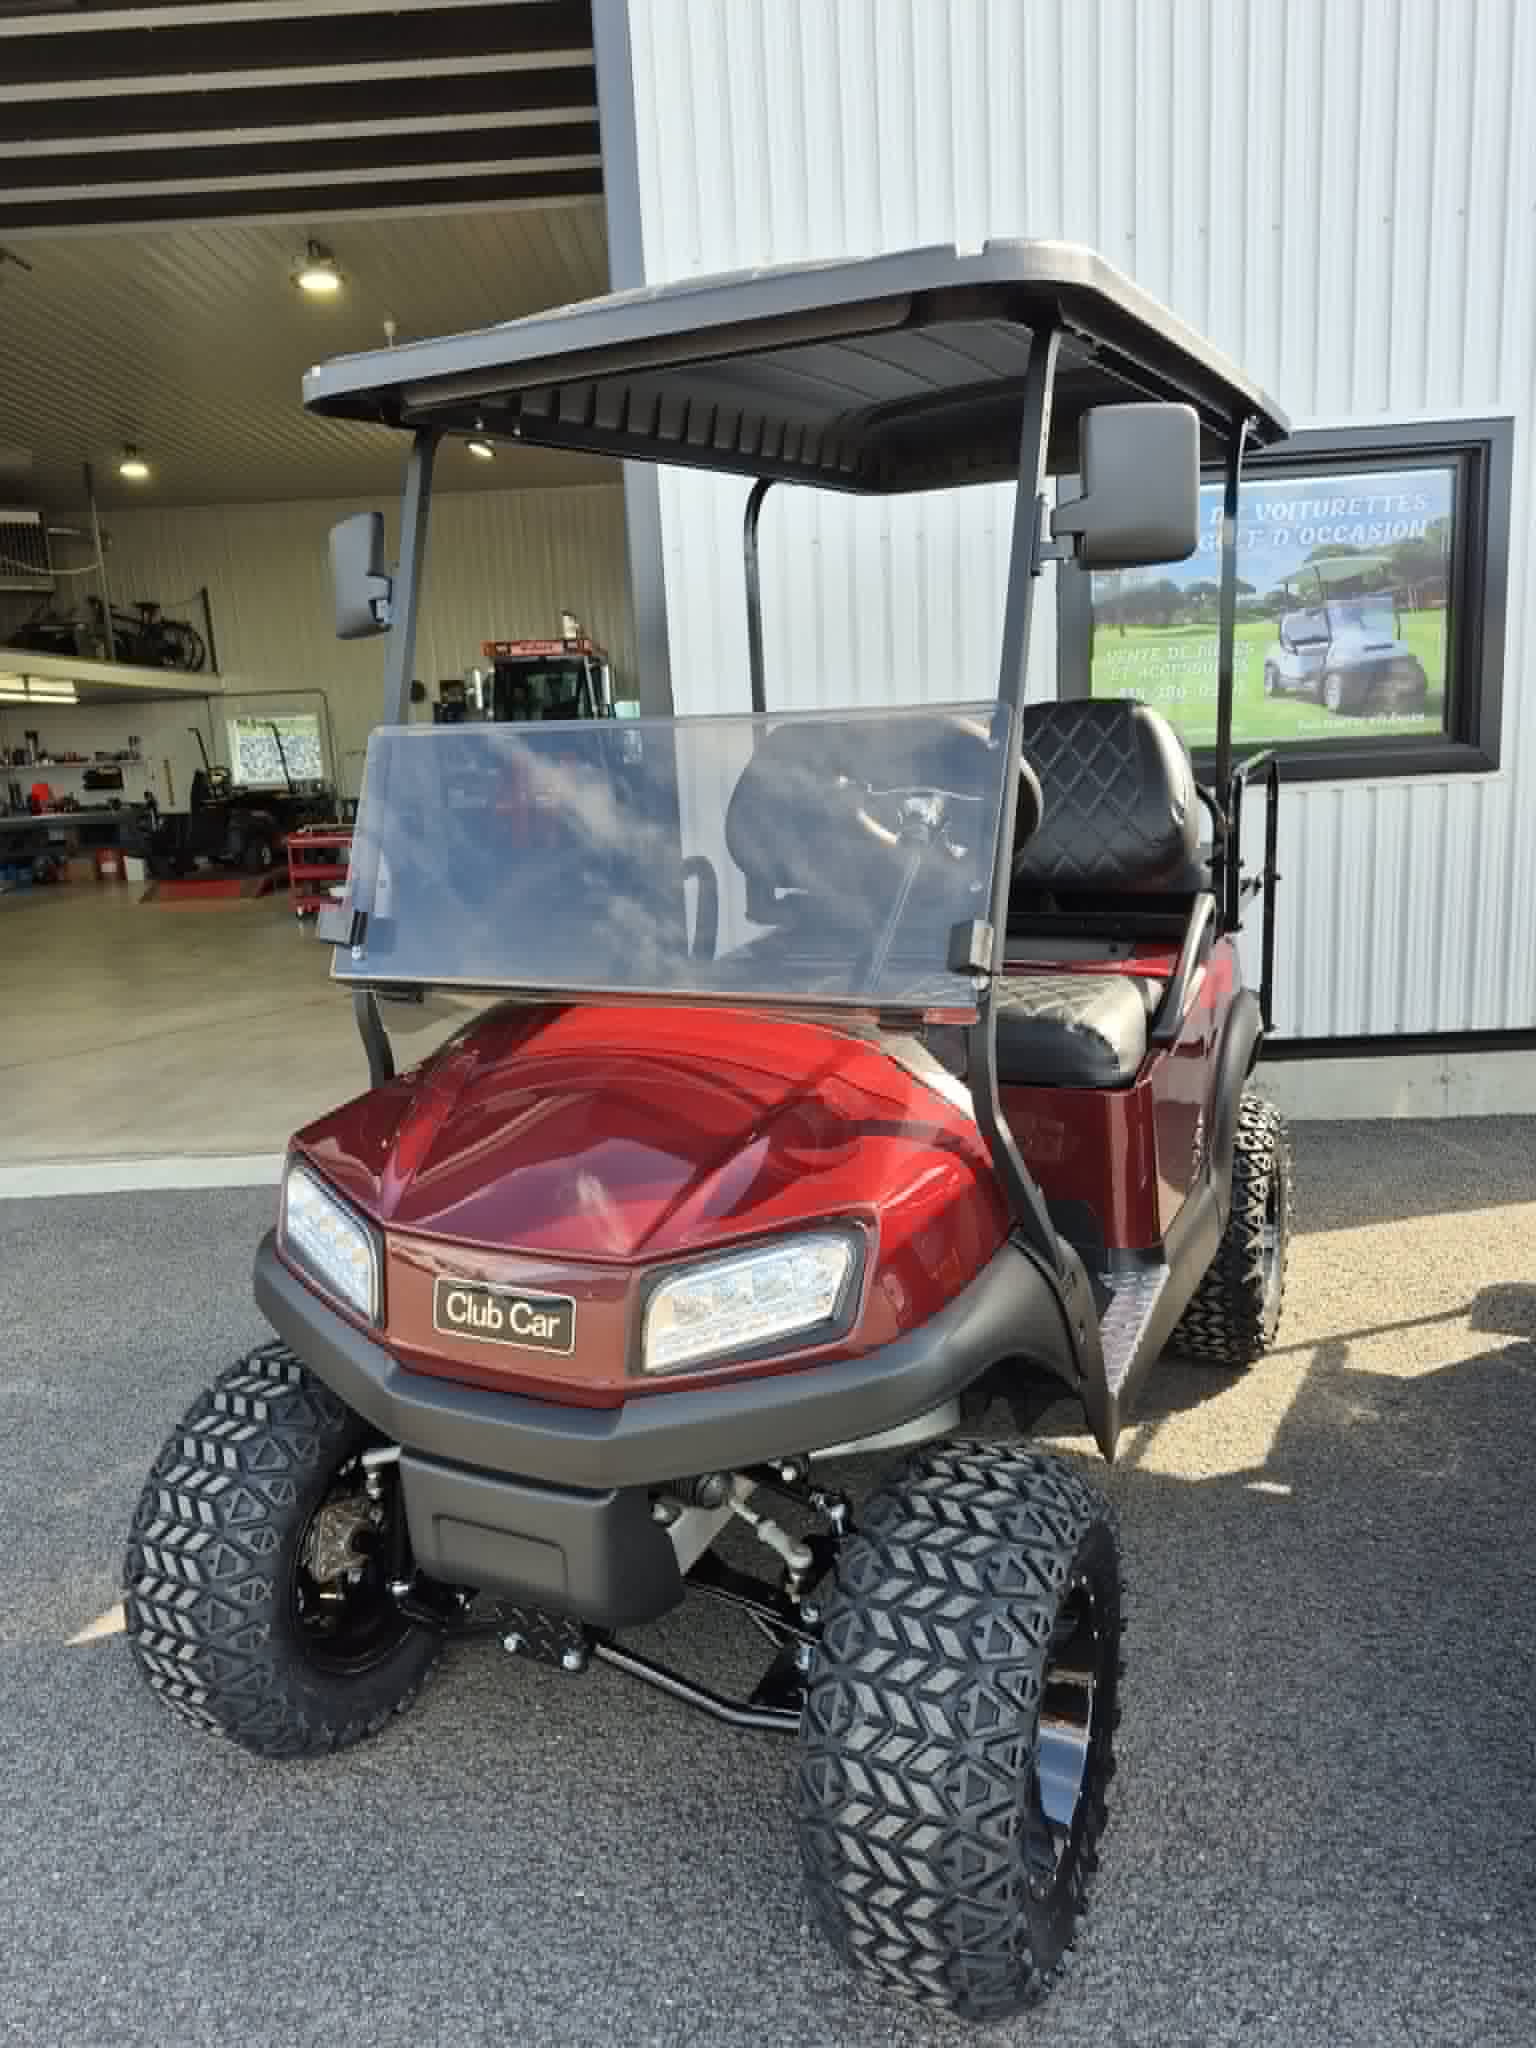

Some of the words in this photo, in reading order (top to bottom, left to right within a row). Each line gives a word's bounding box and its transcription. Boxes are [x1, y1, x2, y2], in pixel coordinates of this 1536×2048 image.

[1255, 493, 1424, 521] VOITURETTES
[1272, 519, 1425, 547] D'OCCASION
[446, 1291, 504, 1329] Club
[509, 1302, 561, 1339] Car
